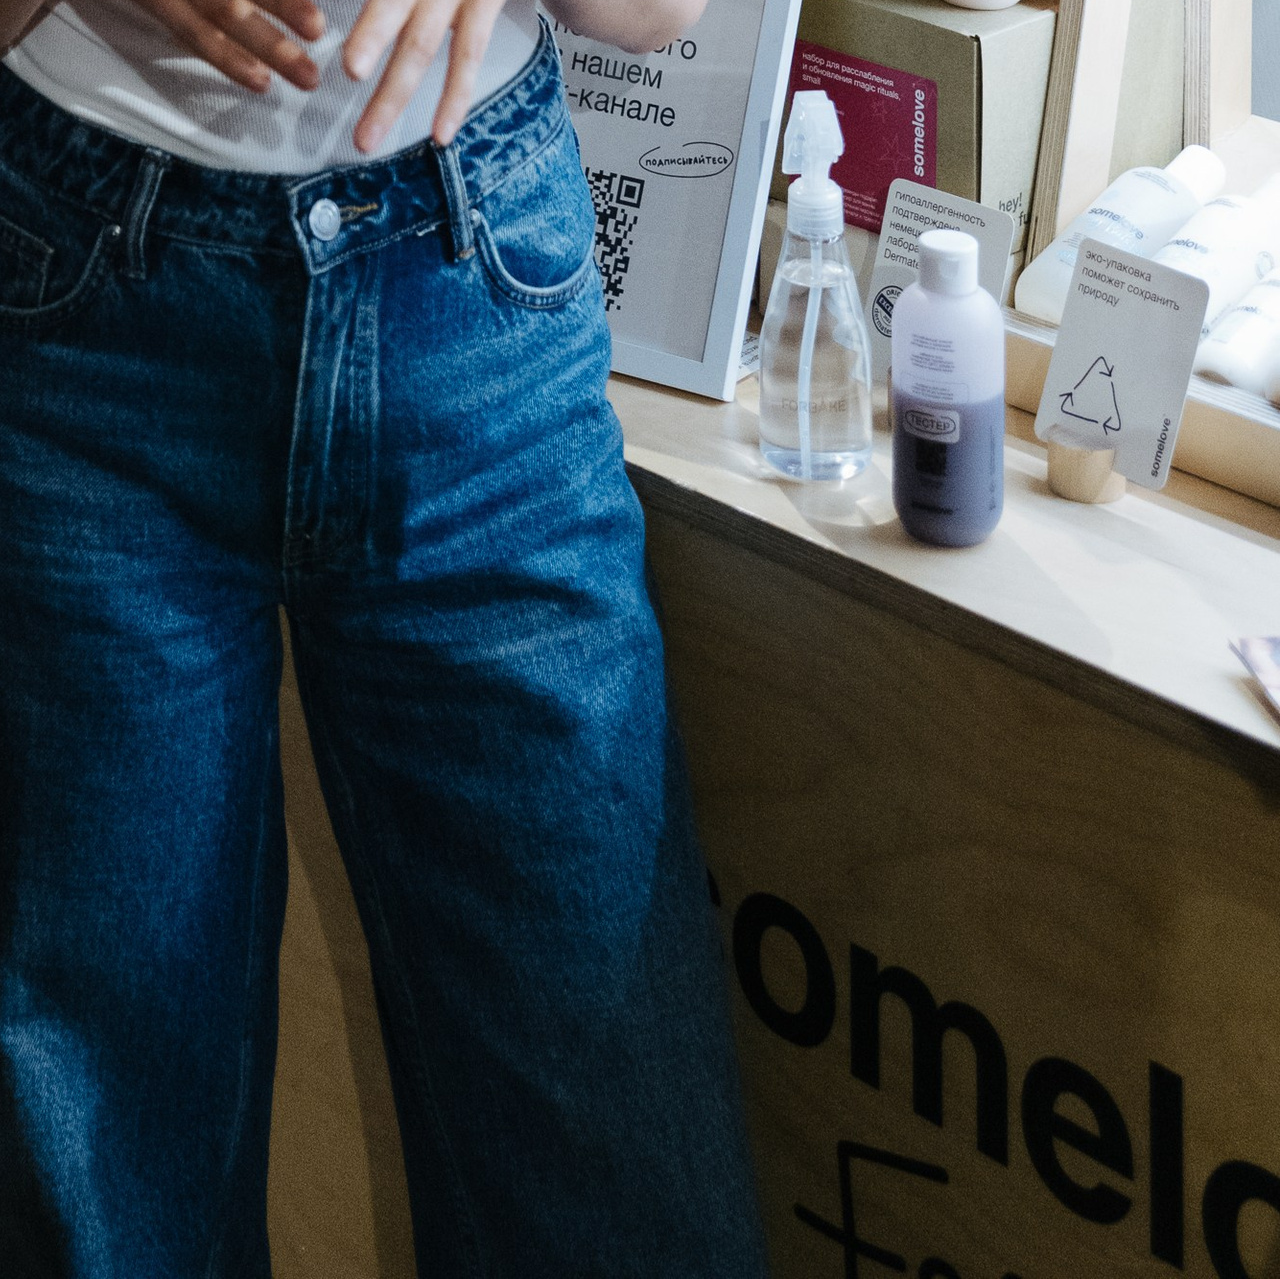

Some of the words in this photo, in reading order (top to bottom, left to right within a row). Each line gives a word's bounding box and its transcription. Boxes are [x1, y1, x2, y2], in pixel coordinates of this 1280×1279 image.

[571, 51, 663, 90] нашем
[802, 52, 826, 66] набор
[825, 60, 841, 70] для
[841, 64, 894, 87] расслабления
[808, 64, 853, 84] обновления
[853, 79, 877, 93] magic
[564, 84, 676, 127] -канале
[912, 88, 926, 177] somelove
[894, 190, 987, 228] гипоаллергенность
[998, 192, 1023, 213] hey!
[883, 247, 920, 270] Dermate
[886, 234, 920, 254] лабора
[1085, 249, 1152, 282] эко-упаковка
[1077, 282, 1120, 308] природу
[1081, 266, 1126, 290] поможет
[1126, 283, 1181, 311] сохранить
[909, 413, 951, 430] ТЕСТЕР
[1150, 417, 1171, 478] somelove
[707, 867, 1280, 1279] omelo
